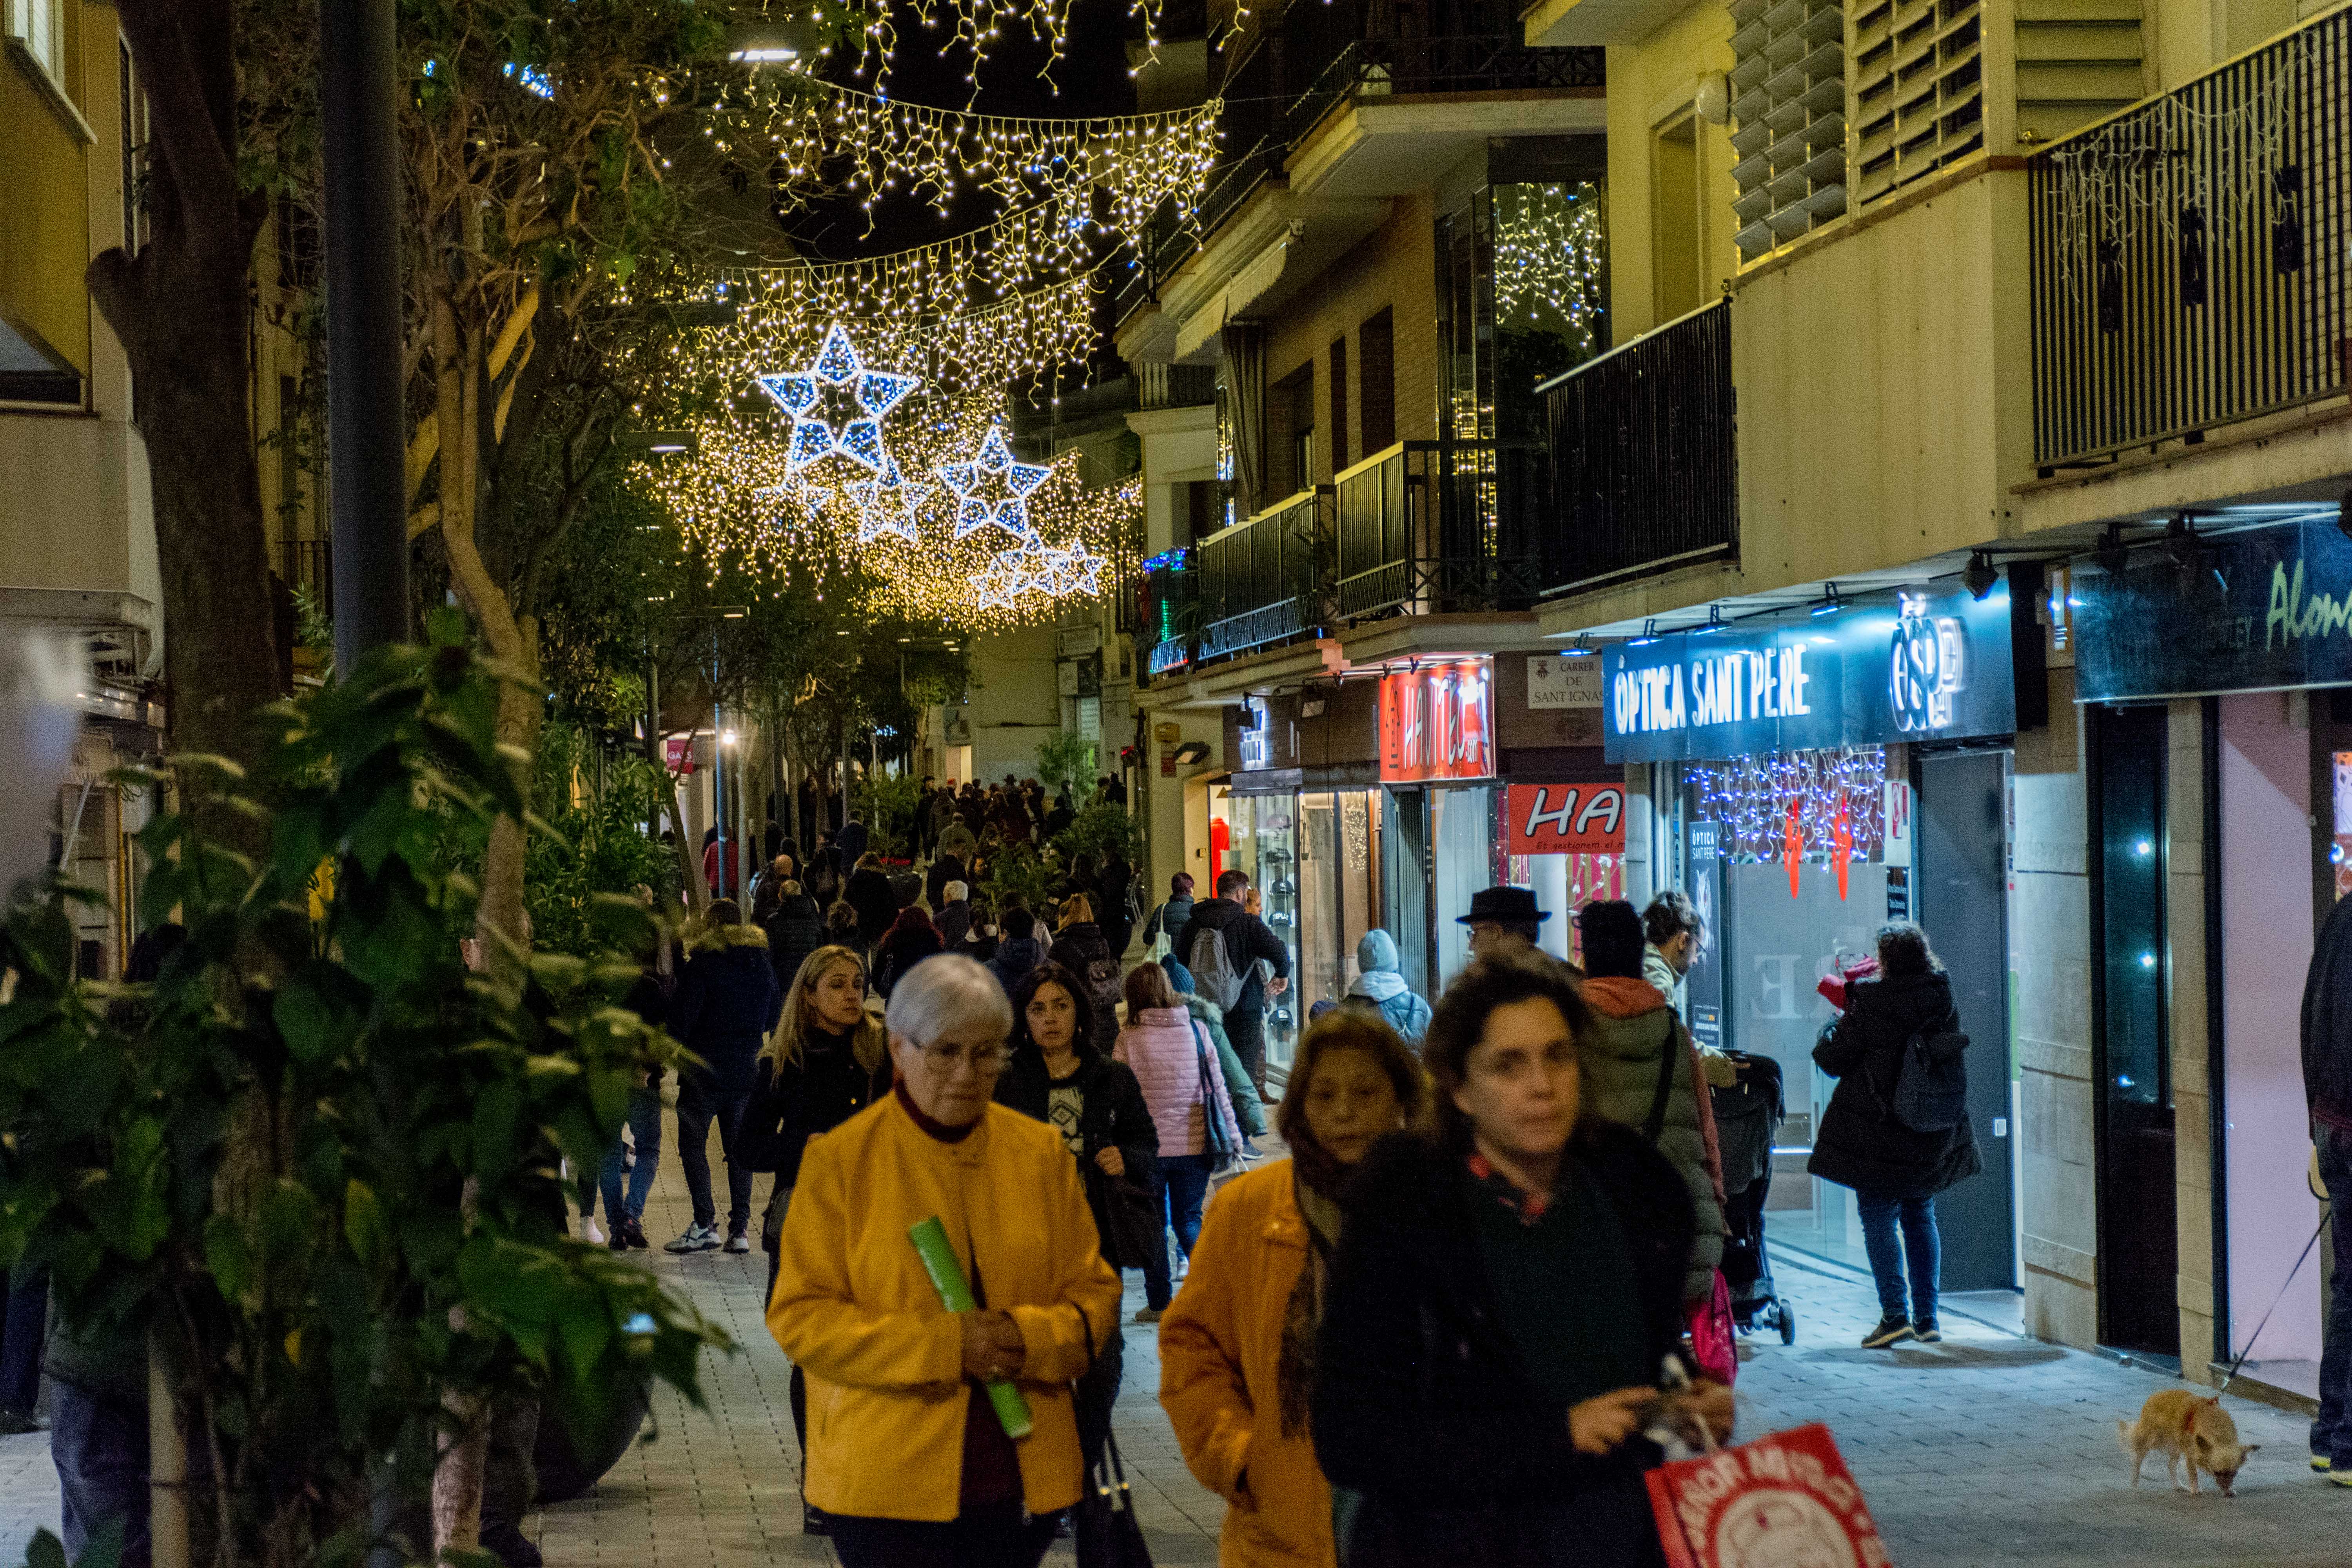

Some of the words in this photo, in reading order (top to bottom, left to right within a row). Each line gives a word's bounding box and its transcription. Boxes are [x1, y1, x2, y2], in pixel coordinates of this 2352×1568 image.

[1560, 662, 1594, 671] CARRER
[1566, 677, 1583, 686] DE
[1615, 655, 1685, 734] ÓPTICA
[1692, 654, 1743, 726] SANT
[1749, 644, 1810, 719] PERE
[1535, 691, 1566, 702] SANT
[668, 751, 692, 759] GAS
[1525, 787, 1624, 837] HA
[1692, 829, 1715, 845] ÓPTICA
[1693, 847, 1704, 860] SANT
[1704, 847, 1715, 860] PERE
